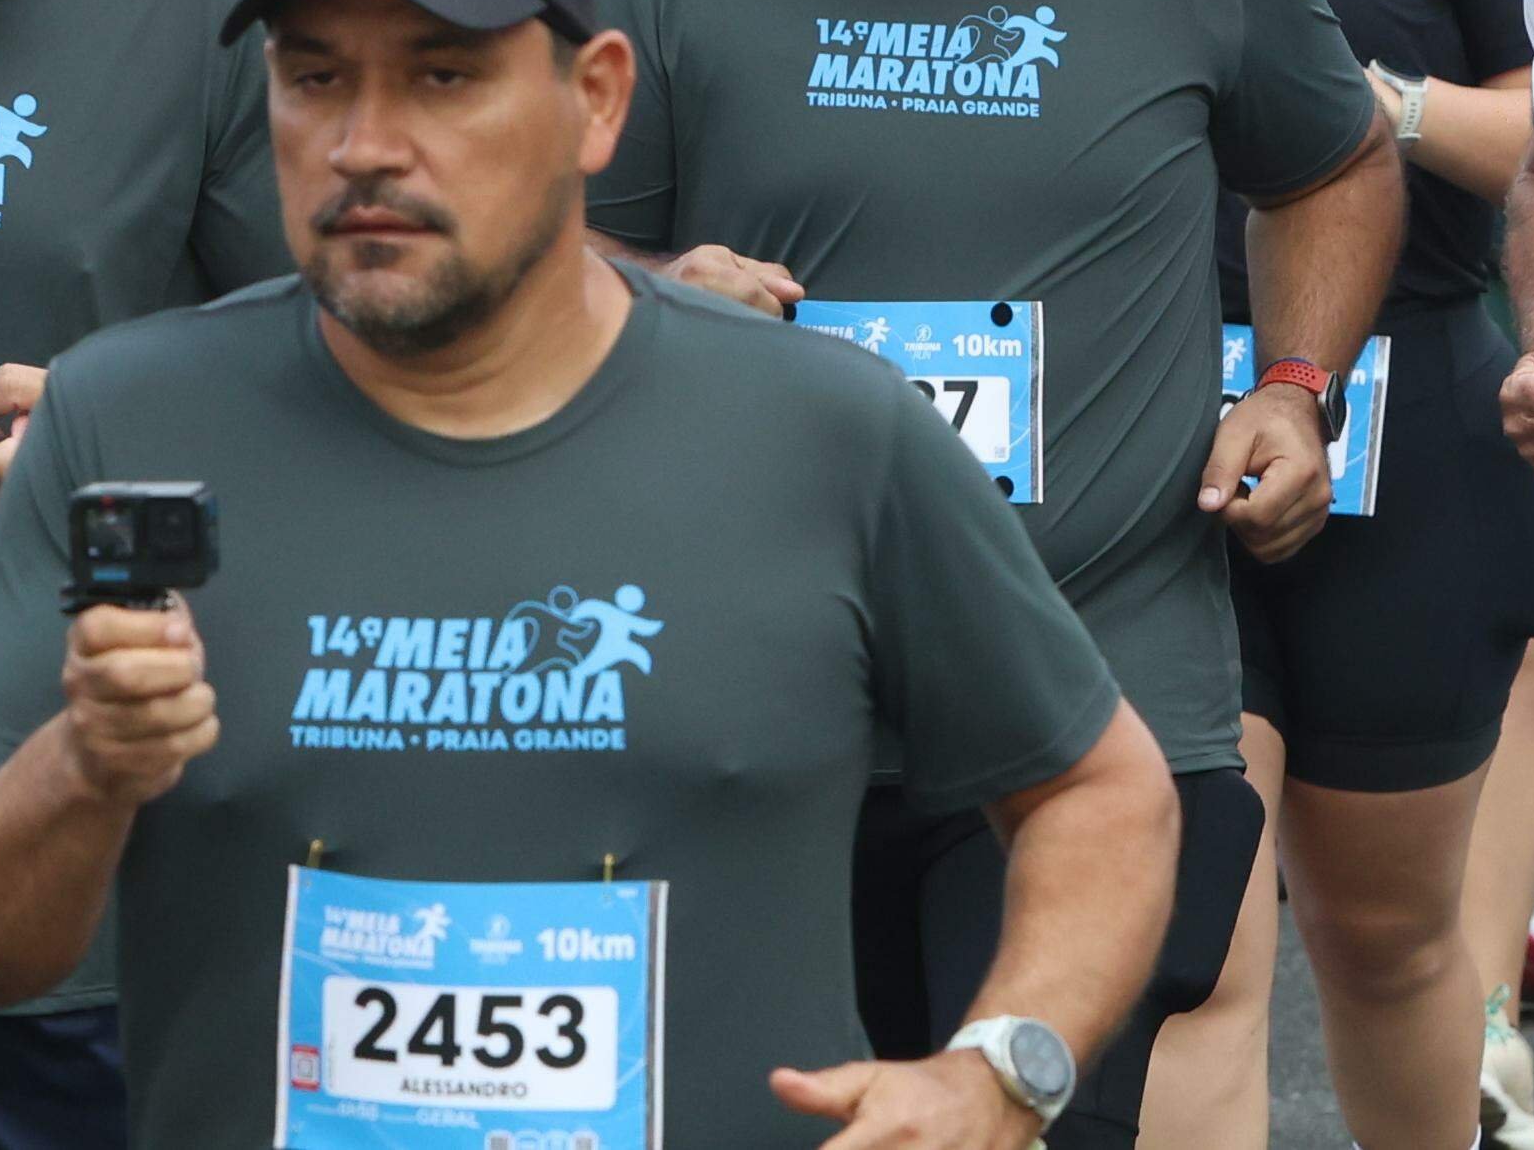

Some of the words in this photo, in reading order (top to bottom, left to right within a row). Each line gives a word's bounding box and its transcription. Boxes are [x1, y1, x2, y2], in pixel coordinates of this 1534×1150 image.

[864, 22, 974, 58] MEIA
[808, 53, 1040, 99] MARATONA
[806, 92, 887, 109] TRIBUNA
[902, 97, 959, 114] PRAIA
[962, 100, 1040, 118] GRANDE
[952, 334, 1022, 358] 10km
[374, 616, 529, 671] MEIA
[291, 667, 625, 724] MARATONA
[289, 724, 404, 750] TRIBUNA
[426, 729, 510, 751] PRAIA
[514, 728, 627, 751] GRANDE
[319, 925, 435, 960] MARATONA
[536, 926, 635, 963] 10km
[353, 985, 587, 1069] 2453
[399, 1076, 528, 1100] ALESSANDRO
